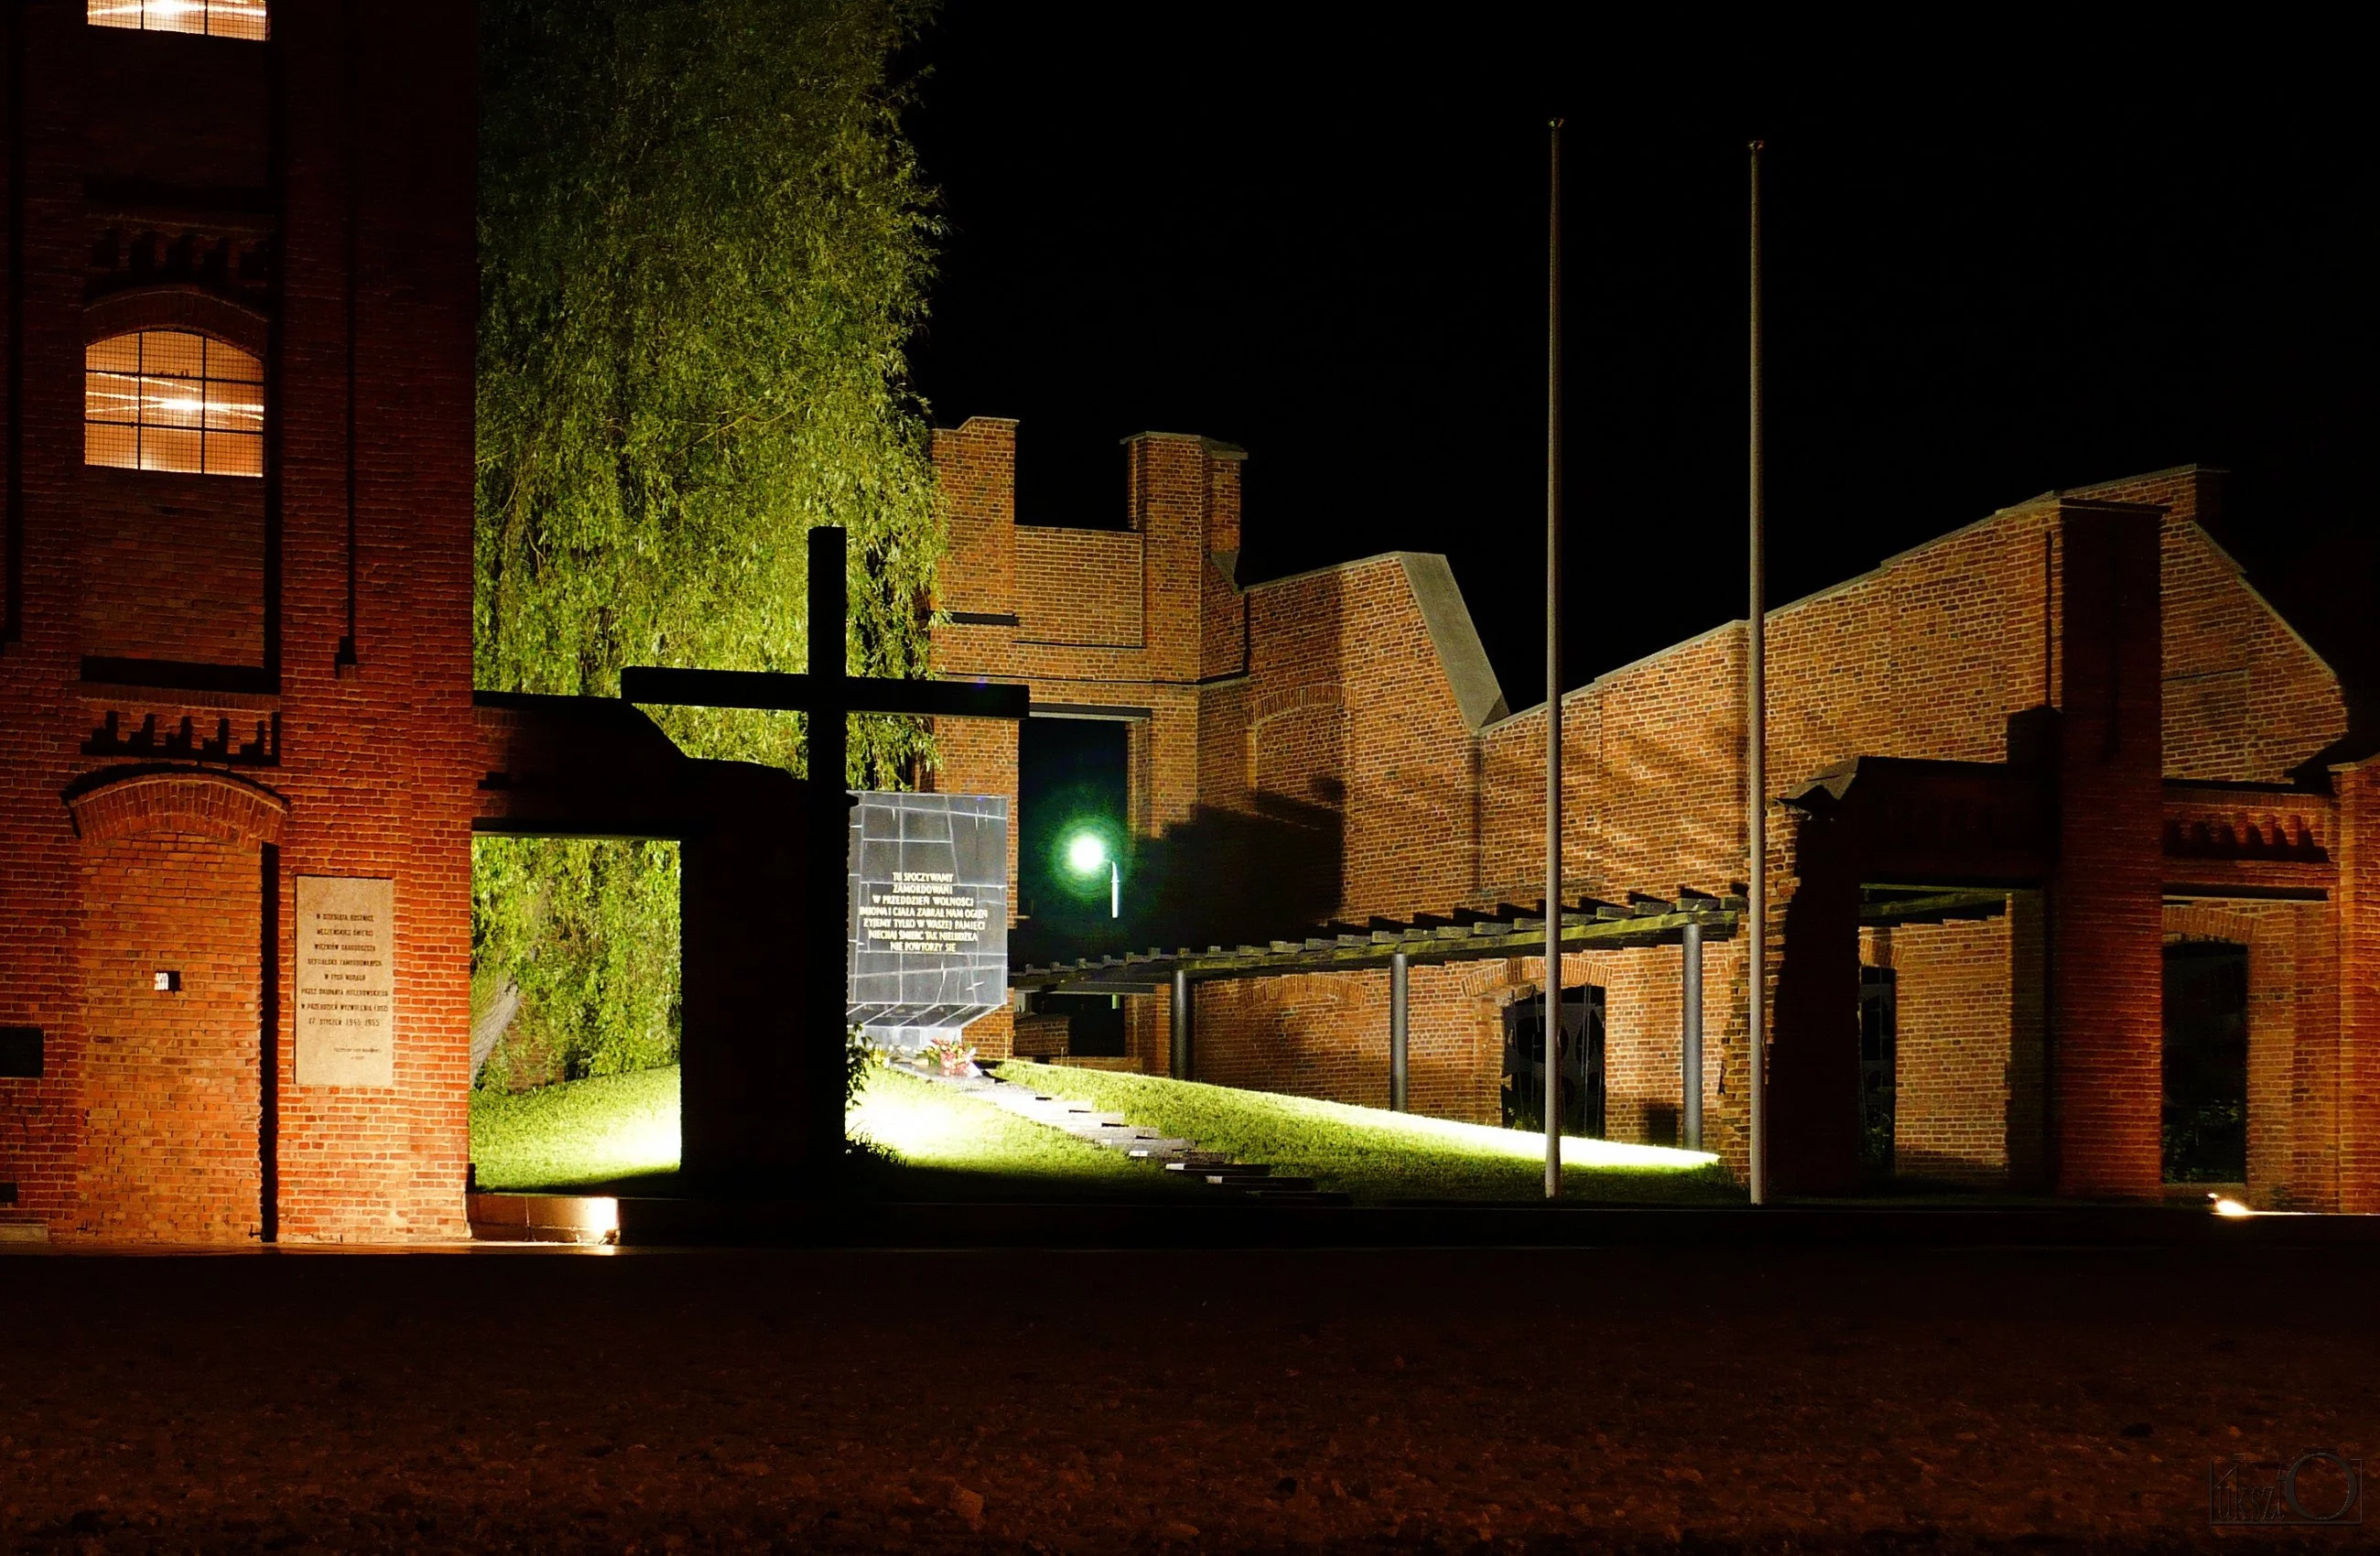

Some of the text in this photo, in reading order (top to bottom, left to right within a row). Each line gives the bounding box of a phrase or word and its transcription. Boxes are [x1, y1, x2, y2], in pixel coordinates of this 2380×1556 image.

[892, 872, 953, 883] TU SPOCZYWAMY
[892, 884, 953, 894] ZAMORDOWANI
[872, 894, 881, 904] W
[859, 907, 887, 916] IMIONA
[888, 907, 892, 916] I
[946, 908, 964, 918] NAM
[893, 919, 915, 928] TYLKO
[917, 919, 925, 928] W
[925, 919, 952, 930] WASZEJ
[890, 942, 903, 951] NIE
